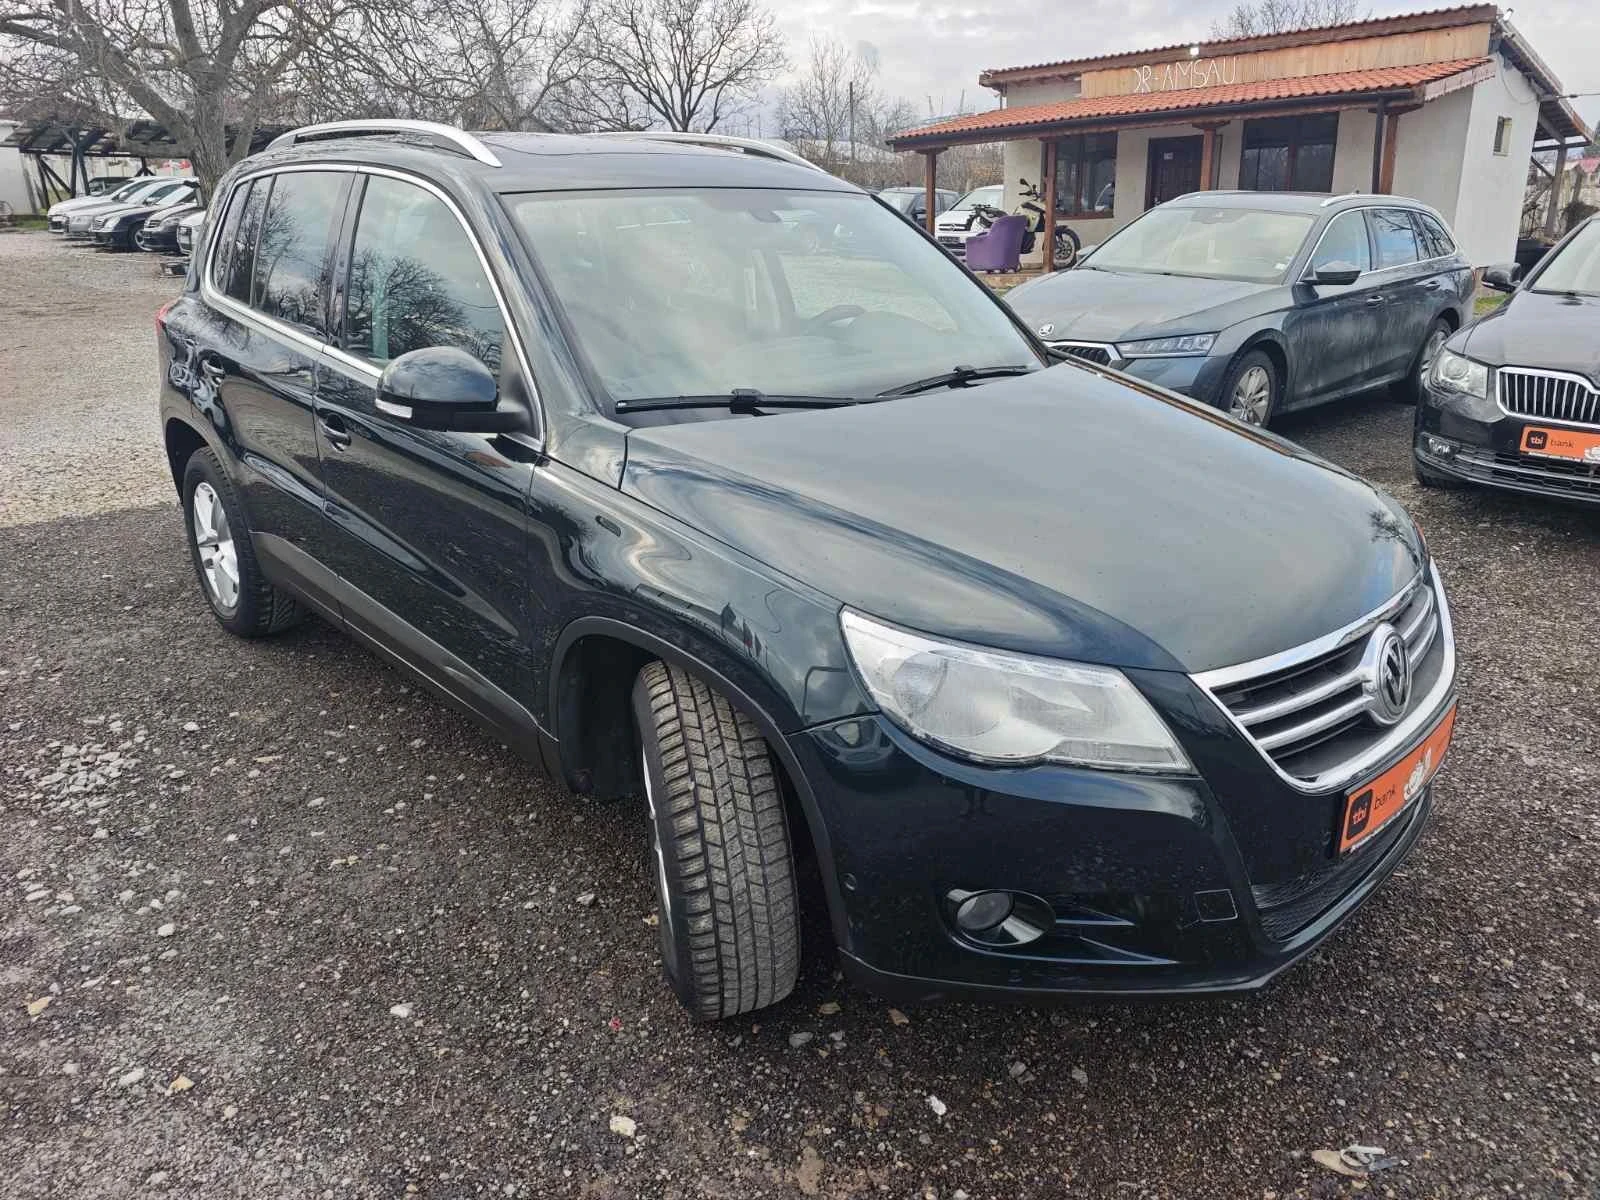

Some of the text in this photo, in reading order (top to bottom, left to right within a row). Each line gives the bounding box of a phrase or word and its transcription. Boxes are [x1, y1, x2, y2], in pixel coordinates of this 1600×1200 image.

[1530, 436, 1574, 449] tbi bank
[1352, 803, 1368, 825] tbi
